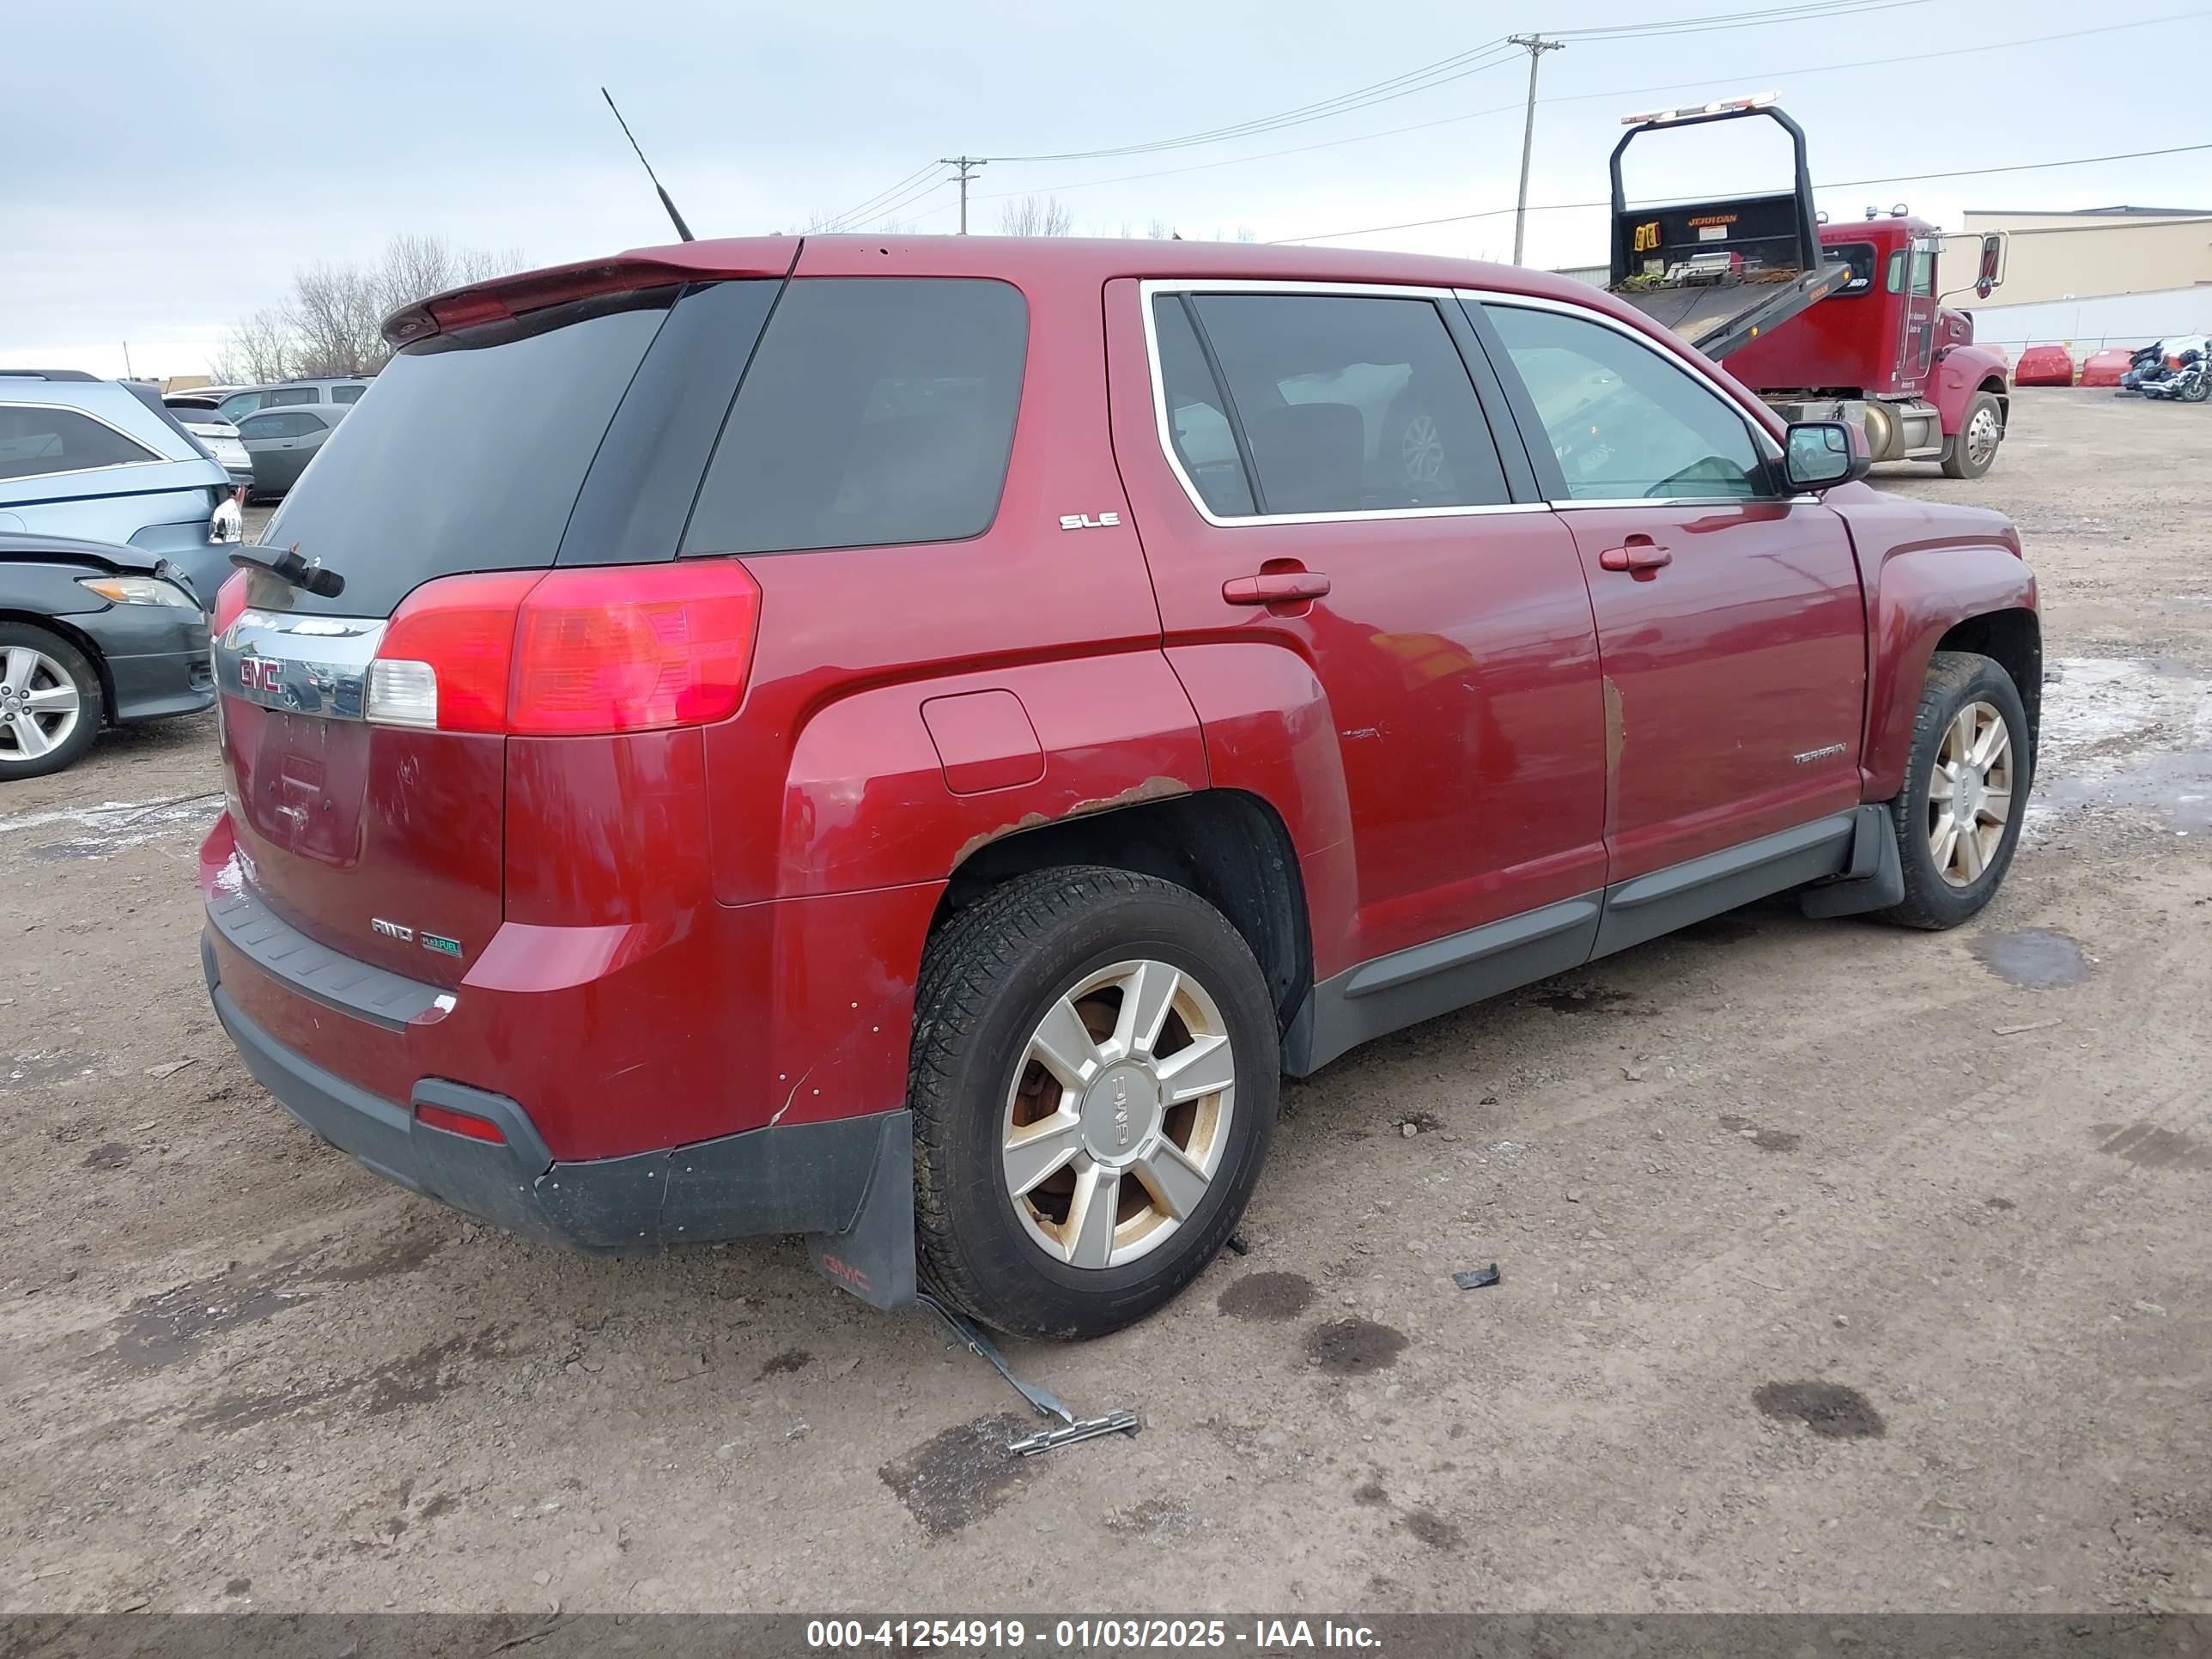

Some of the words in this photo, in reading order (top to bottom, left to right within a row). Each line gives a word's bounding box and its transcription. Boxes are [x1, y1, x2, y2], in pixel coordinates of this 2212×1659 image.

[1059, 512, 1121, 530] SLE
[240, 656, 286, 694] GMC
[1793, 742, 1847, 765] TERRAIN
[371, 917, 414, 942] AWD
[1112, 1076, 1129, 1145] GMC
[823, 1253, 872, 1291] GMC
